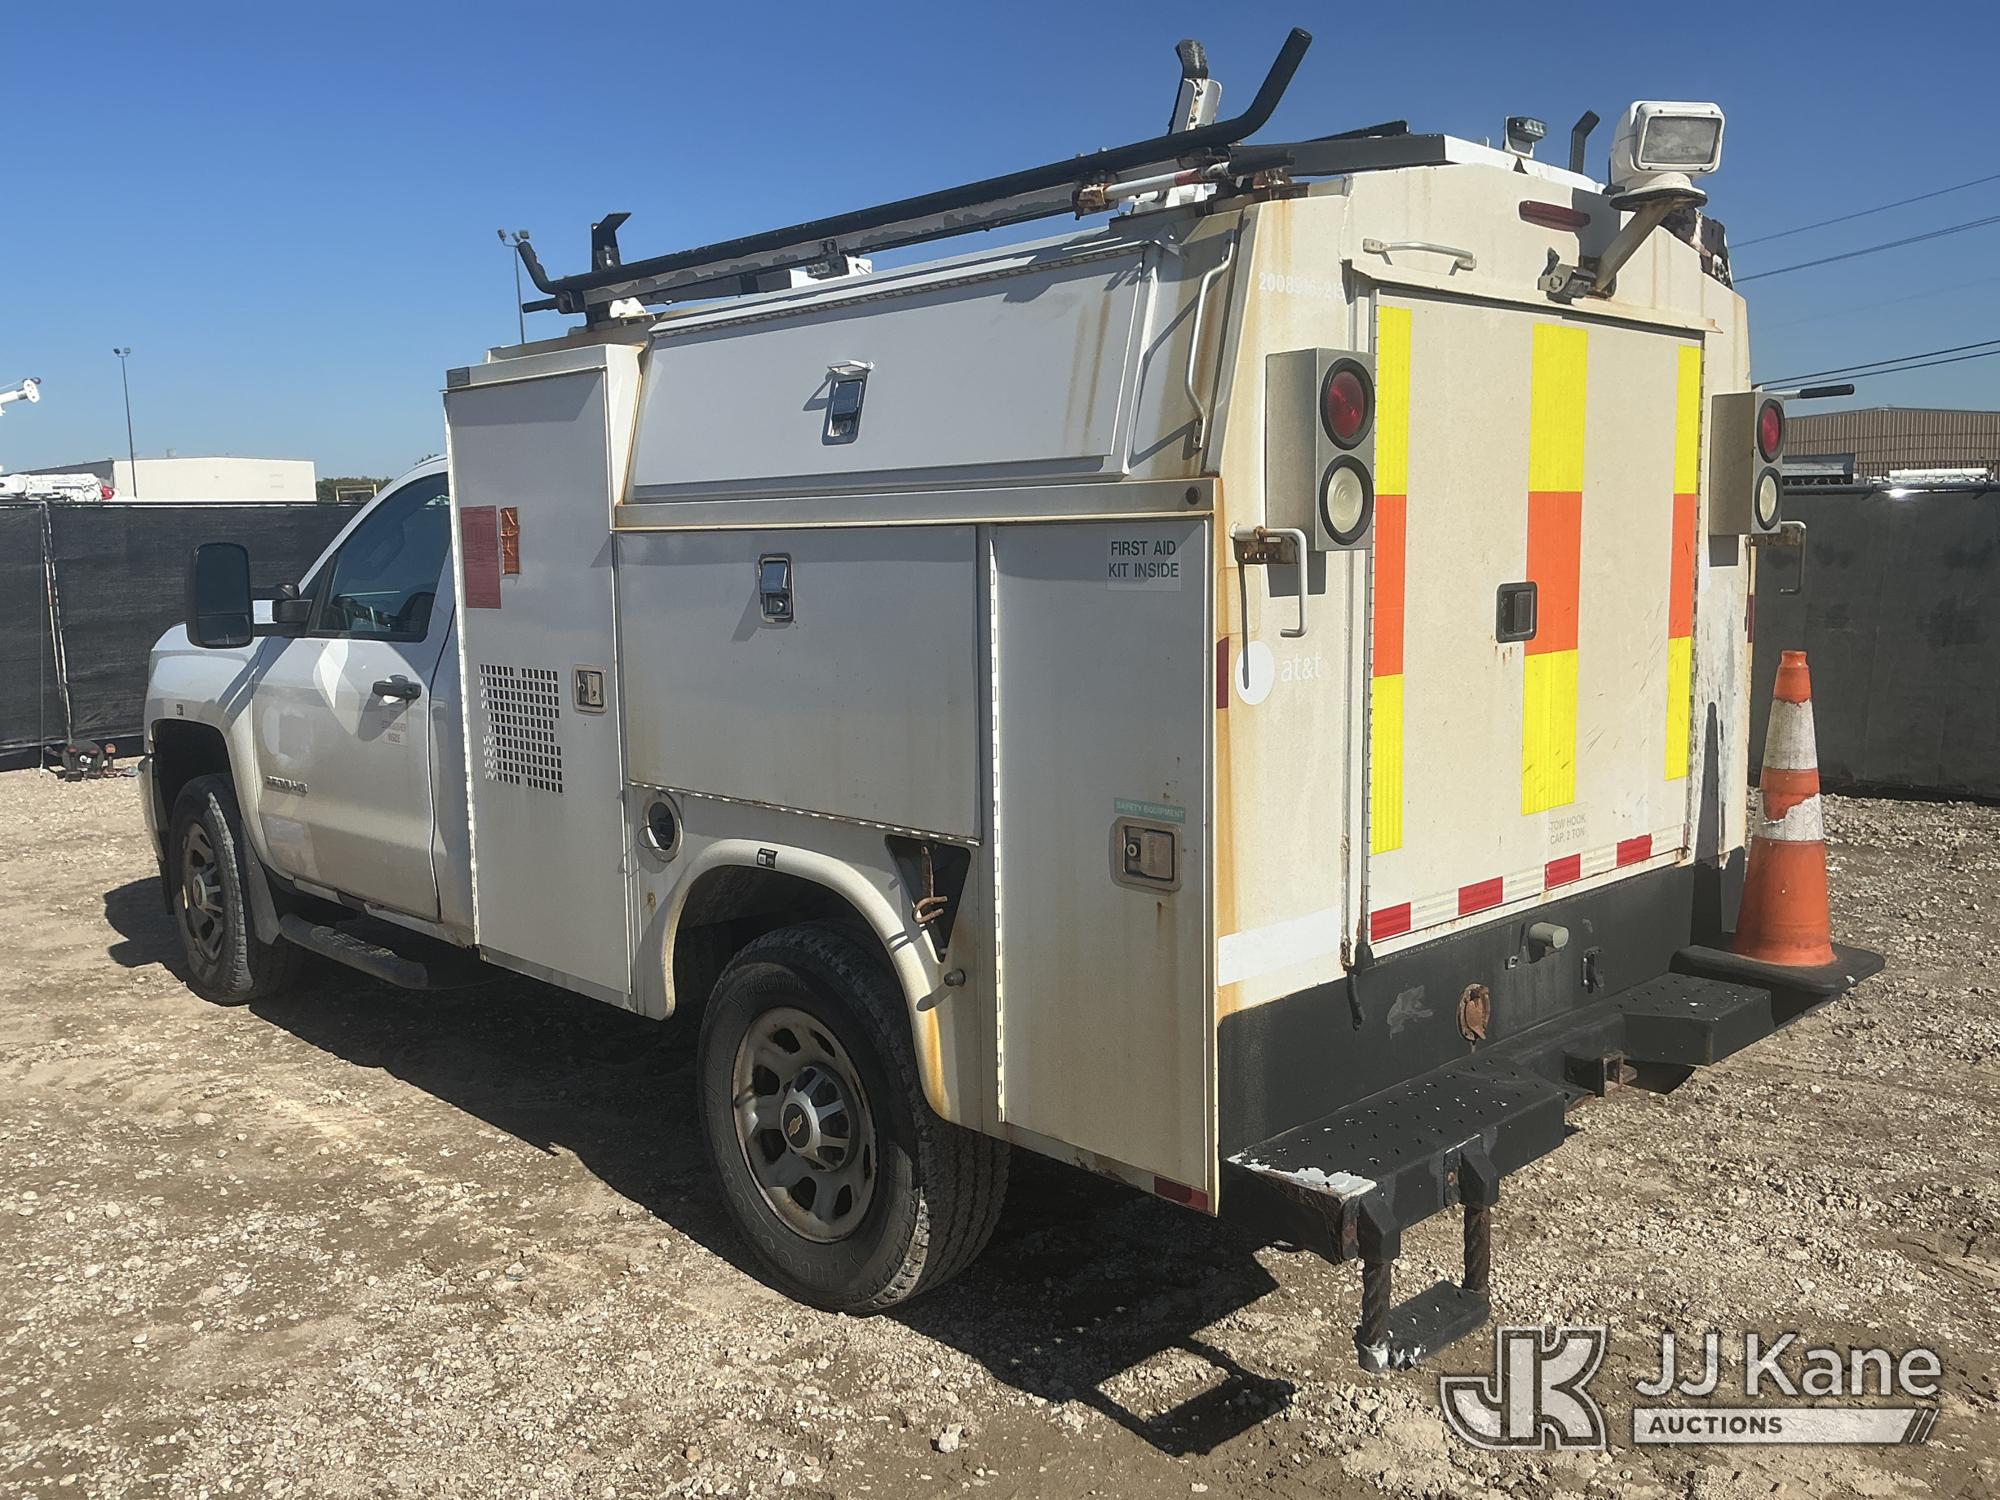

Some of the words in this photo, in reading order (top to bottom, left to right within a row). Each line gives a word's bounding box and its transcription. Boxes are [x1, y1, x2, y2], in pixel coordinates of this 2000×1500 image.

[1111, 541, 1148, 556] FIRST
[1153, 540, 1176, 556] AID
[1108, 562, 1129, 578] KIT
[1134, 562, 1179, 578] INSIDE
[1281, 653, 1322, 683] at&t
[1143, 804, 1184, 818] EQUIPMENT
[1550, 819, 1566, 831] TOW
[1566, 813, 1586, 827] HOOK
[1571, 826, 1586, 840] TON
